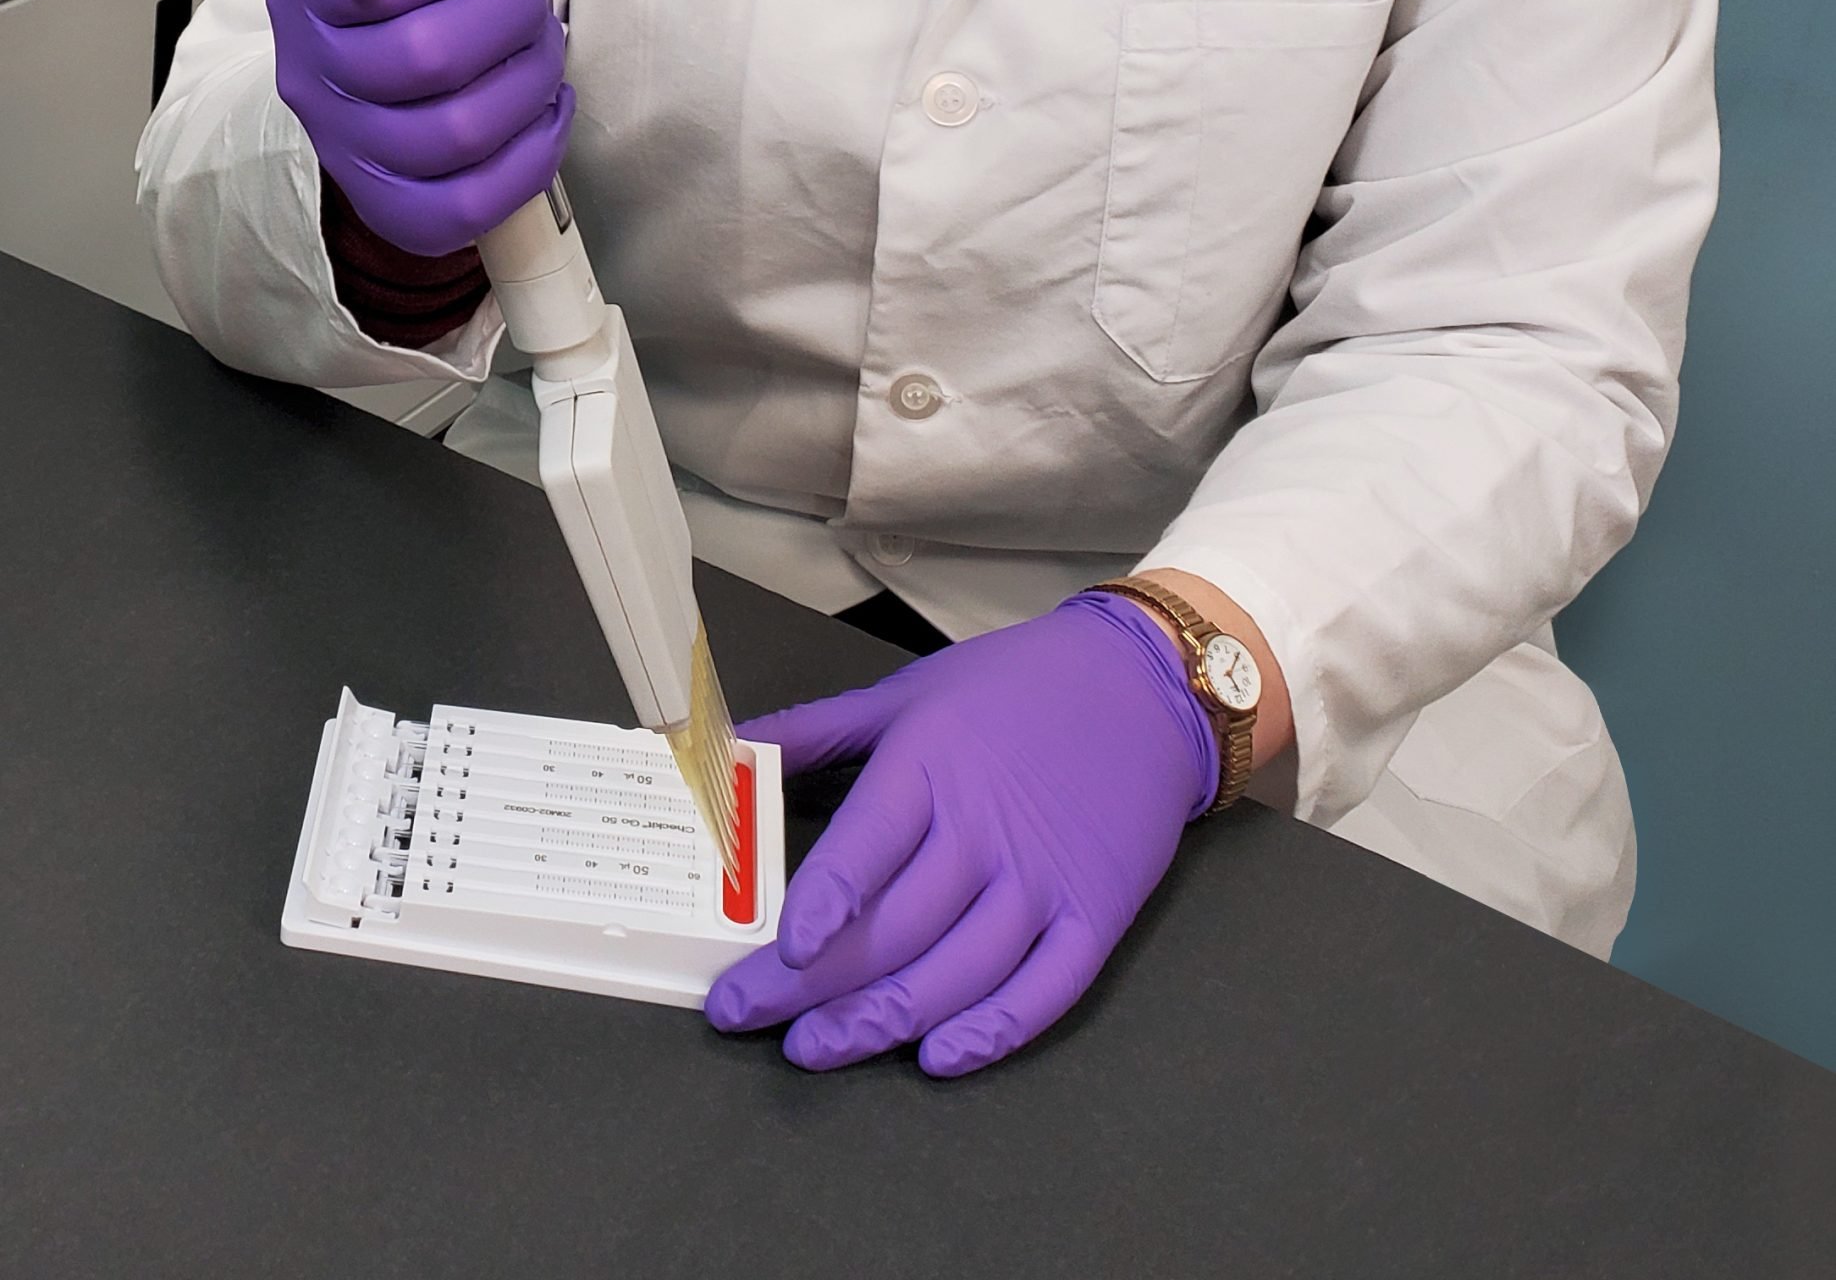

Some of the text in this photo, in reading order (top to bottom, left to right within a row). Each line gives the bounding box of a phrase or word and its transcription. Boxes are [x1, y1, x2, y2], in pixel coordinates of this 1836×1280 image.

[543, 764, 556, 773] 30
[591, 770, 604, 778] 40
[637, 775, 653, 785] 50
[602, 816, 618, 824] 50
[621, 818, 640, 827] Go
[534, 854, 548, 862] 30
[585, 860, 598, 868] 40
[633, 865, 649, 876] 50
[687, 872, 701, 880] 60
